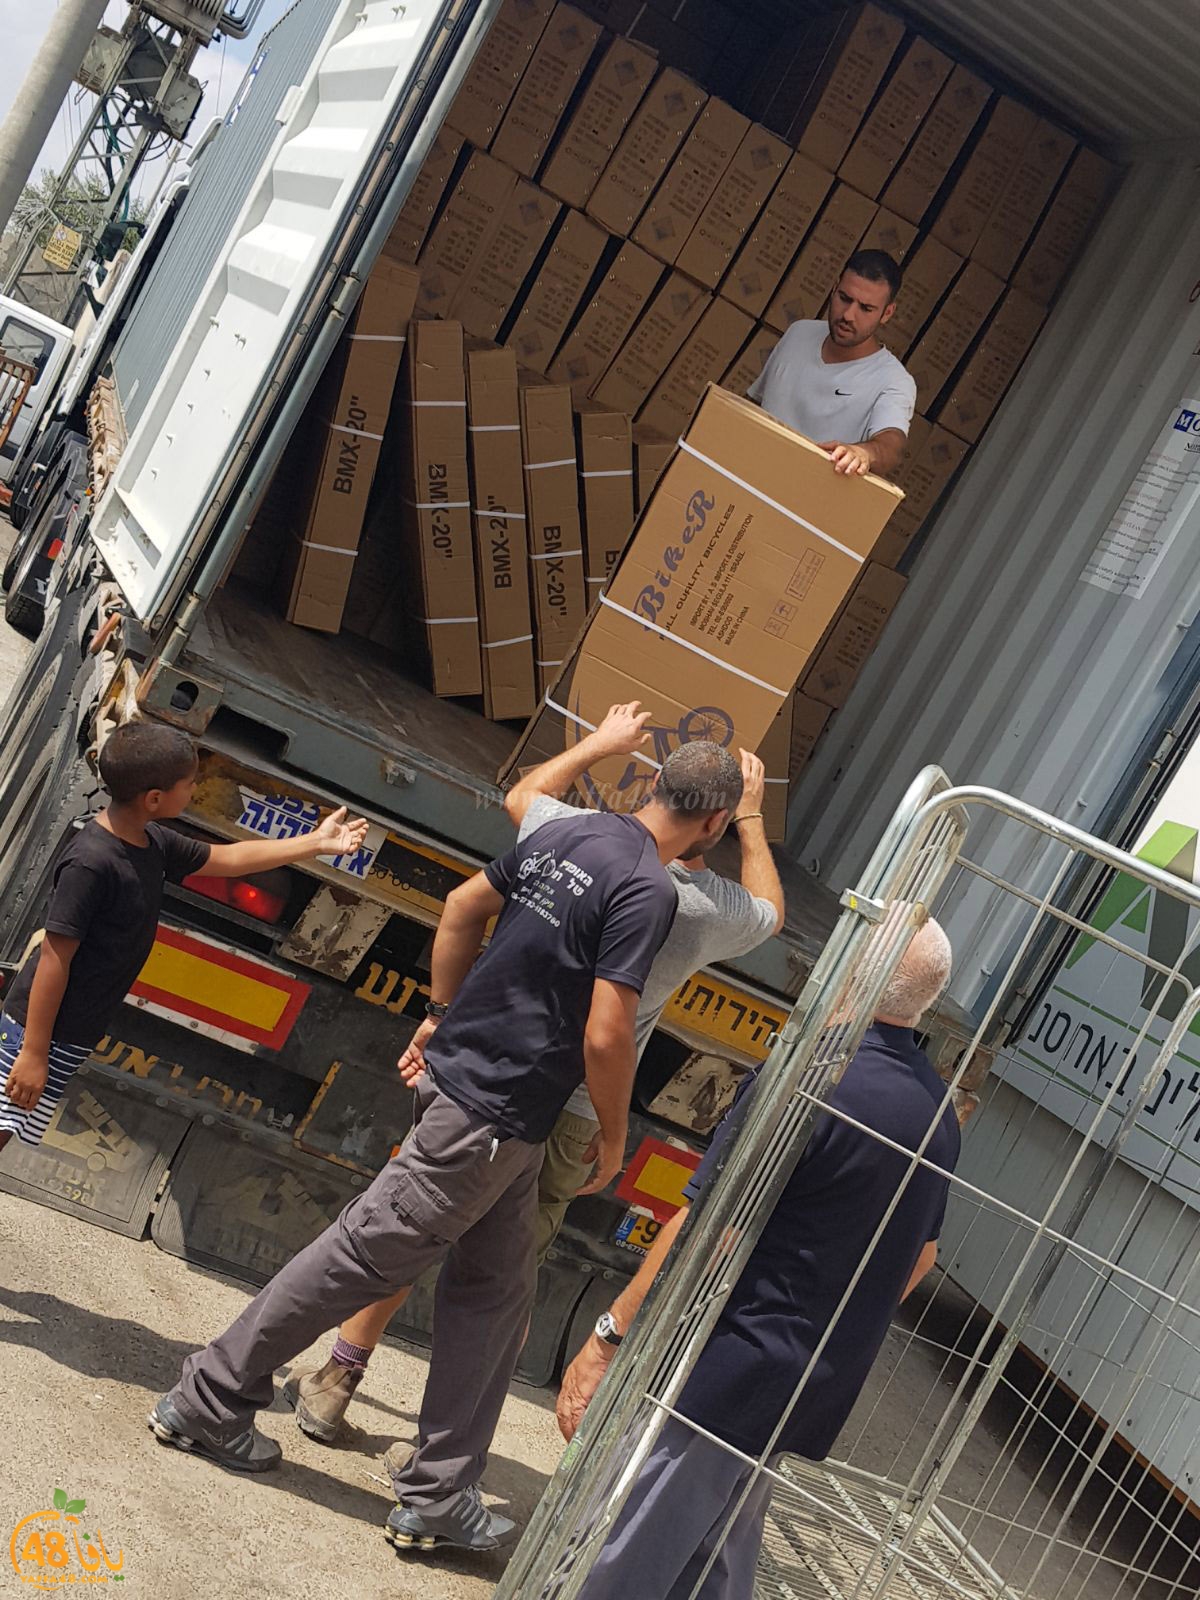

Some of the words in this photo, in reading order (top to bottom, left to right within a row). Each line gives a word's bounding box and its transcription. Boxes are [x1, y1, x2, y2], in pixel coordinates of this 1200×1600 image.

[333, 395, 367, 494] BMX-20"
[428, 463, 452, 558] BMX-20"
[488, 495, 512, 589] BMX-20"
[703, 503, 736, 559] BICYCLES
[728, 513, 754, 554] DISTRIBUTION
[543, 525, 568, 616] BMX-20"
[632, 490, 715, 631] BikeR
[567, 877, 585, 896] של
[620, 1216, 632, 1231] IL
